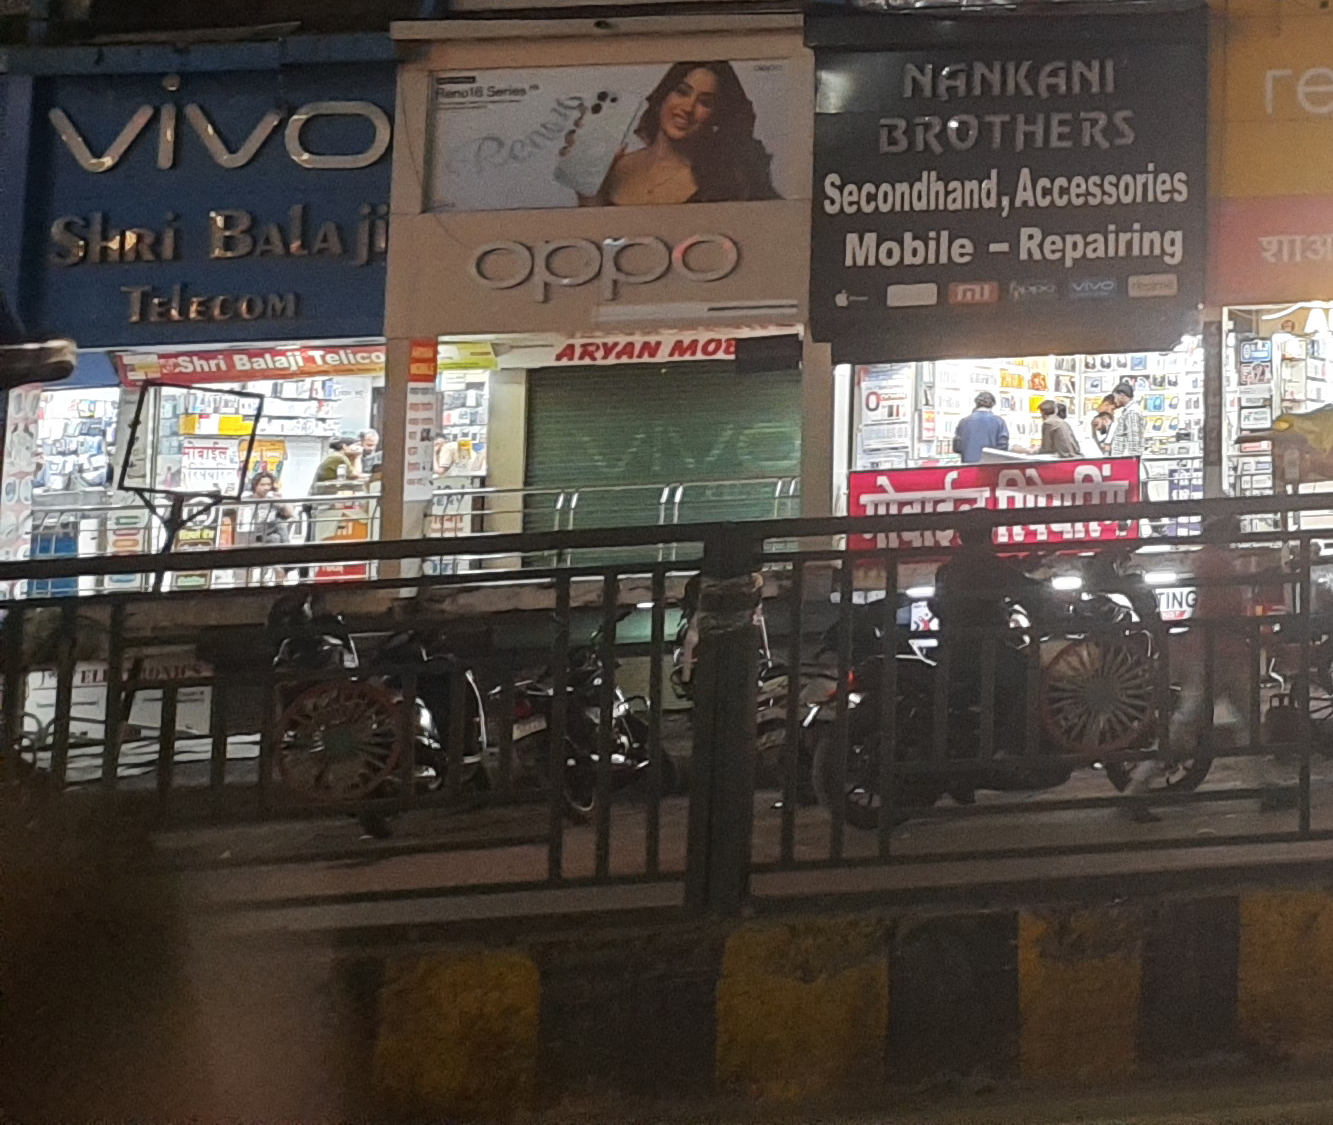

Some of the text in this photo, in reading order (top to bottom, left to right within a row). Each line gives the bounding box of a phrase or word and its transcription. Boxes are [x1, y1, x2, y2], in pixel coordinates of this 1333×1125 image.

[902, 57, 1116, 103] NANKANI
[49, 74, 392, 173] vivo
[878, 109, 1136, 156] BROTHERS
[1014, 162, 1189, 209] Accessories
[50, 211, 184, 269] Shri
[844, 229, 975, 268] Mobile
[1019, 222, 1185, 269] Repairing
[470, 233, 741, 304] oppo
[175, 354, 228, 375] Shri
[234, 350, 306, 372] Balaji
[554, 340, 663, 363] ARYAN
